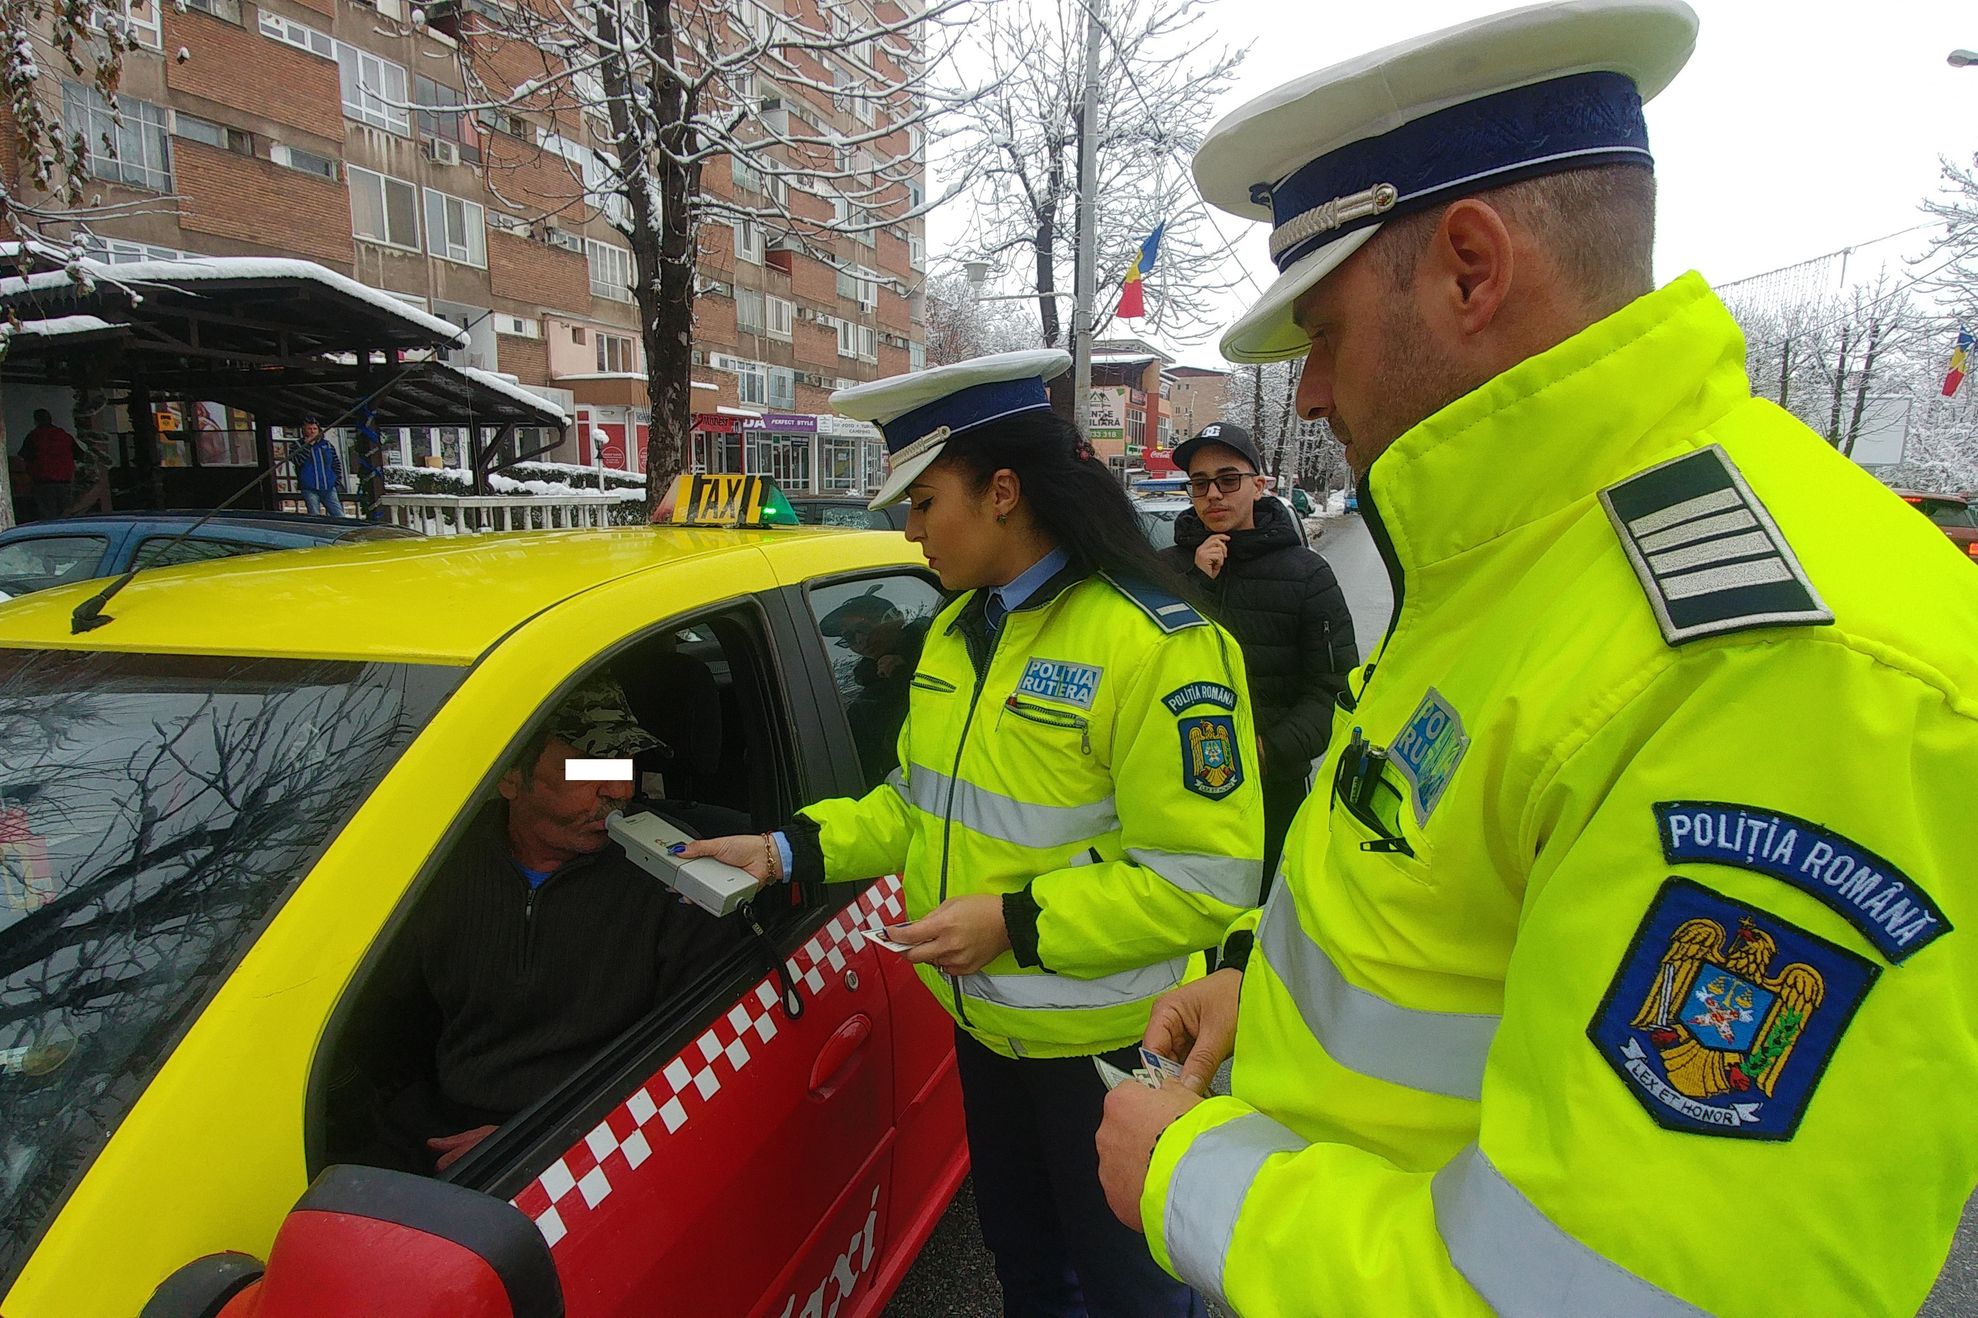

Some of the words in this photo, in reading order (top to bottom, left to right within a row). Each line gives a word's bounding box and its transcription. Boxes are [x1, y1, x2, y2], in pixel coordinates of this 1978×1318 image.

[686, 475, 756, 525] TAXI
[1800, 840, 1938, 947] ROMÂNĂ
[1632, 1063, 1659, 1091] LEX
[1659, 1088, 1681, 1105] ET
[1680, 1100, 1734, 1124] HONOR
